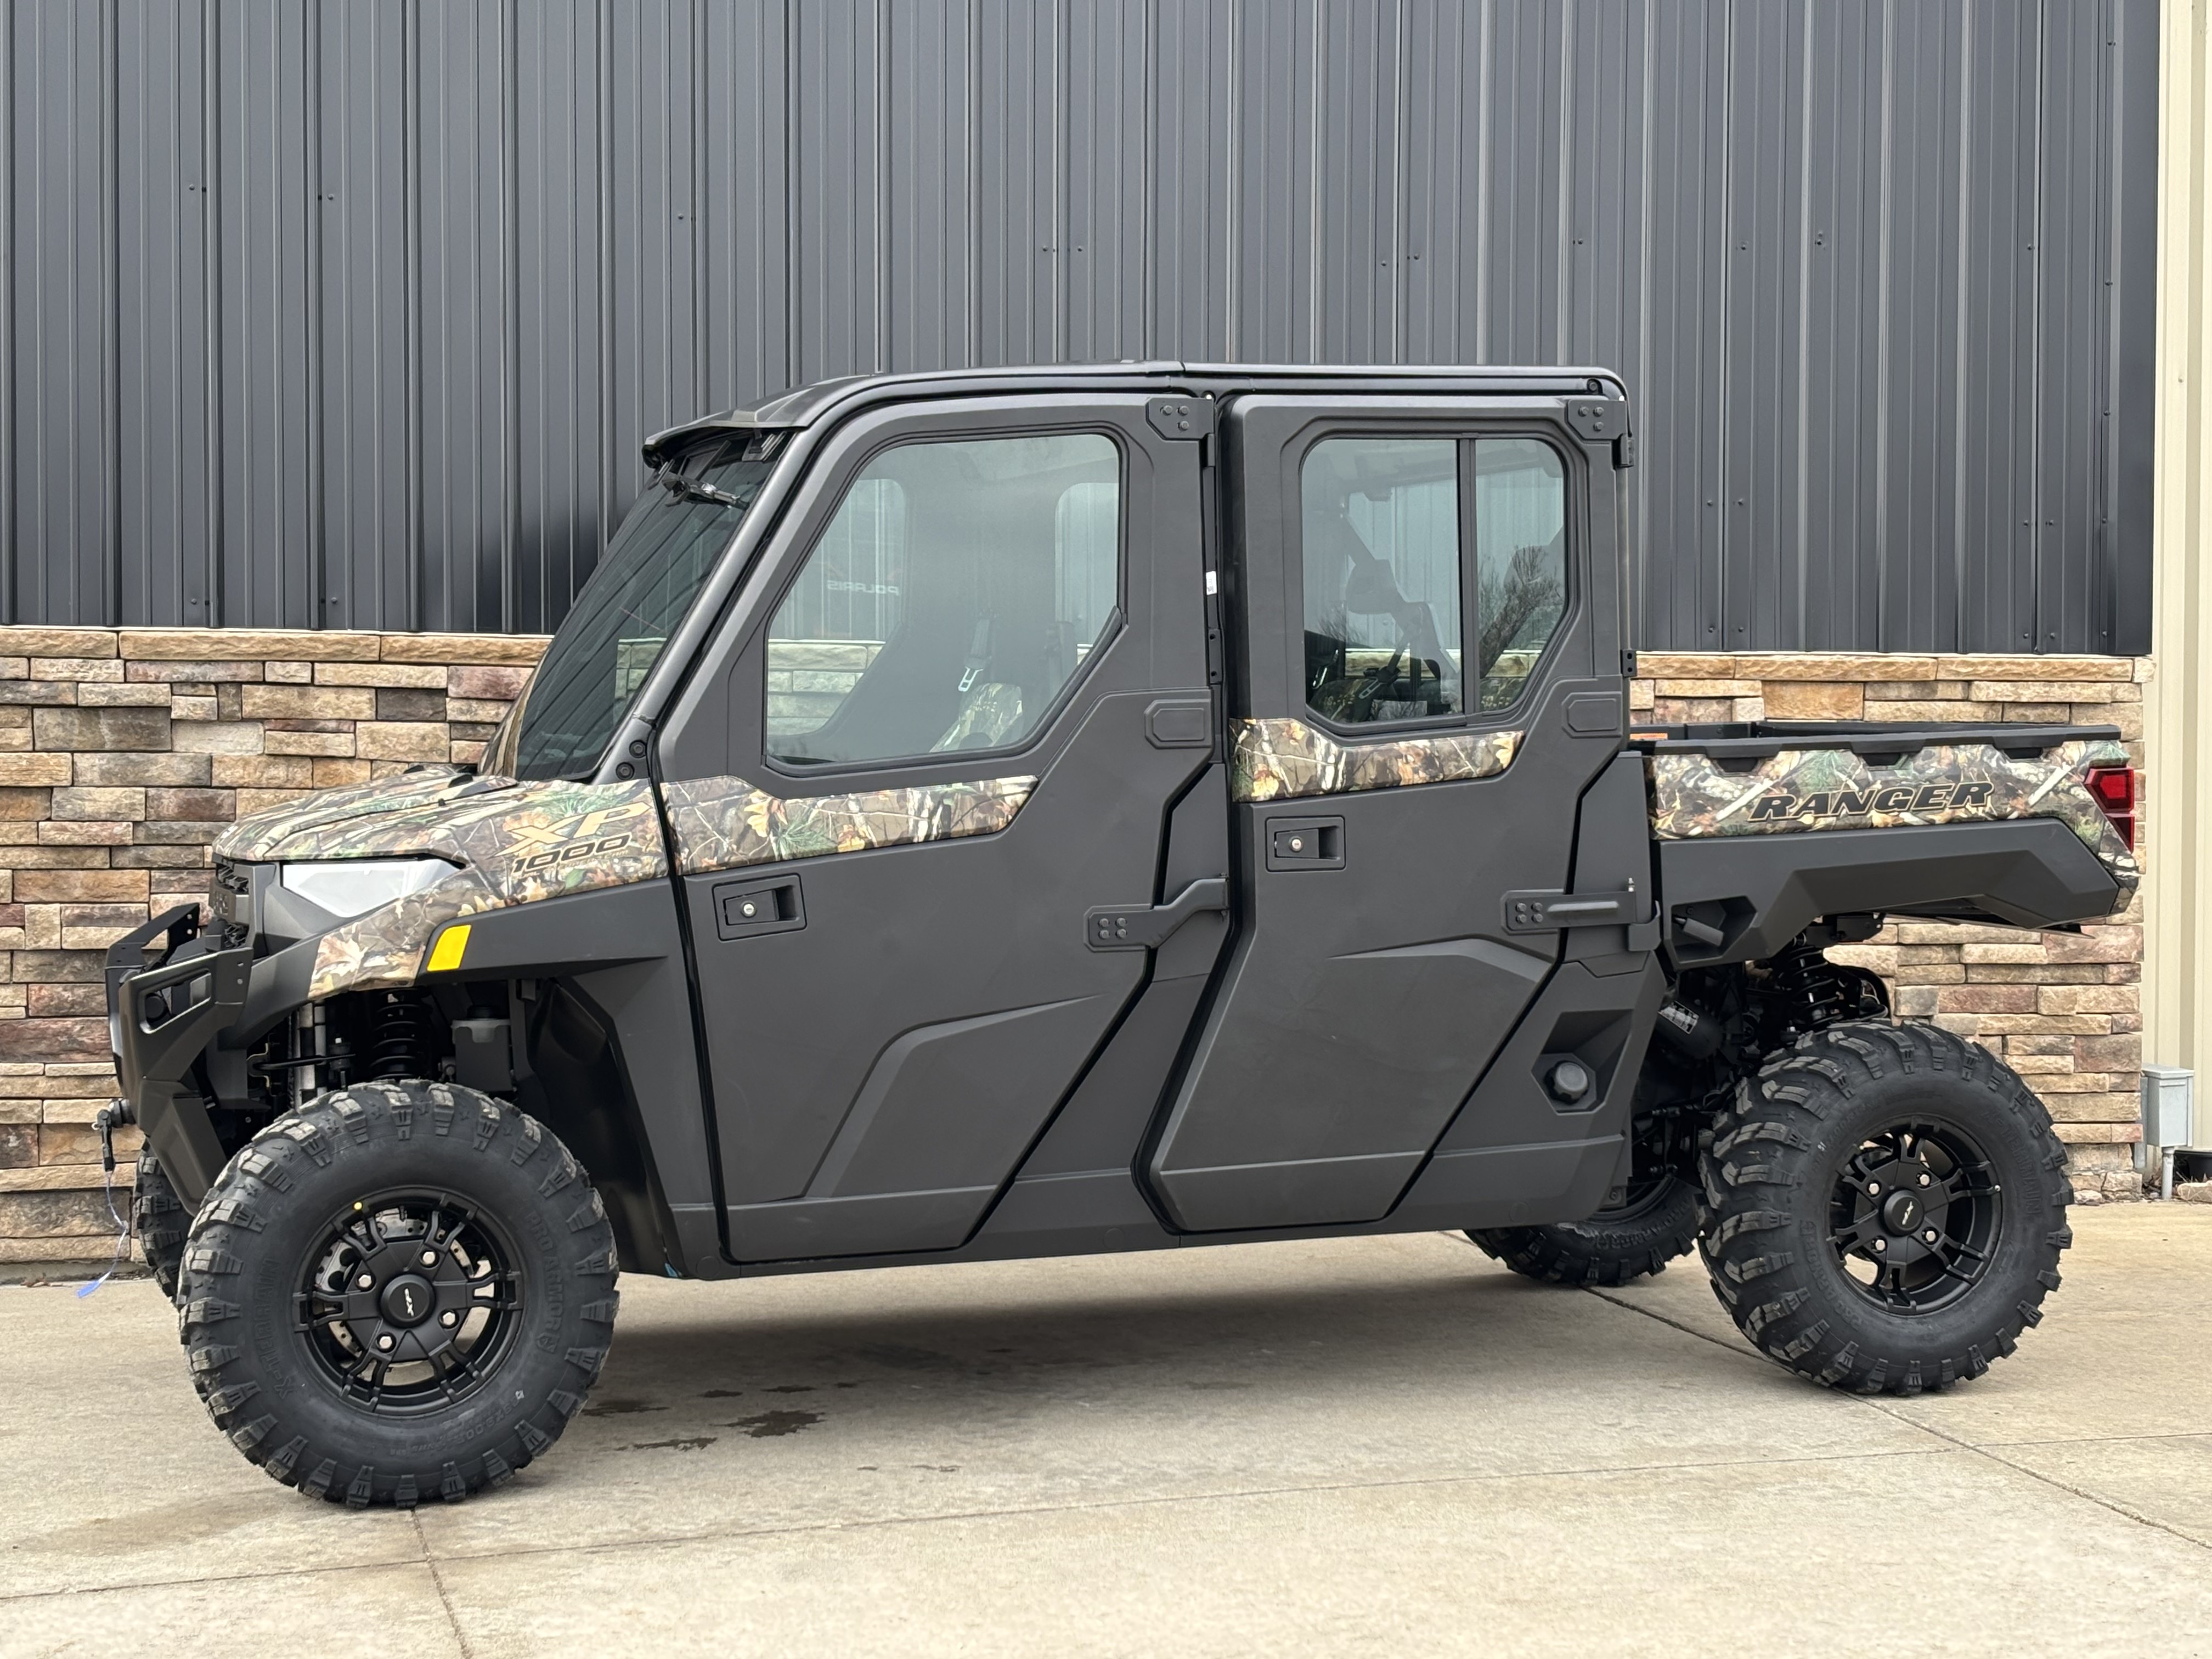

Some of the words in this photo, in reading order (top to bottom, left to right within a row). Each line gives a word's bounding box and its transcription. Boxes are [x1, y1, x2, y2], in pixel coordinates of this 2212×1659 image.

[488, 801, 652, 858] XP
[1747, 781, 1995, 822] RANGER
[510, 832, 633, 875] 1000
[524, 1210, 554, 1251] PRO
[543, 1256, 563, 1330] ARMOR
[253, 1257, 295, 1400] X-TERRAIN
